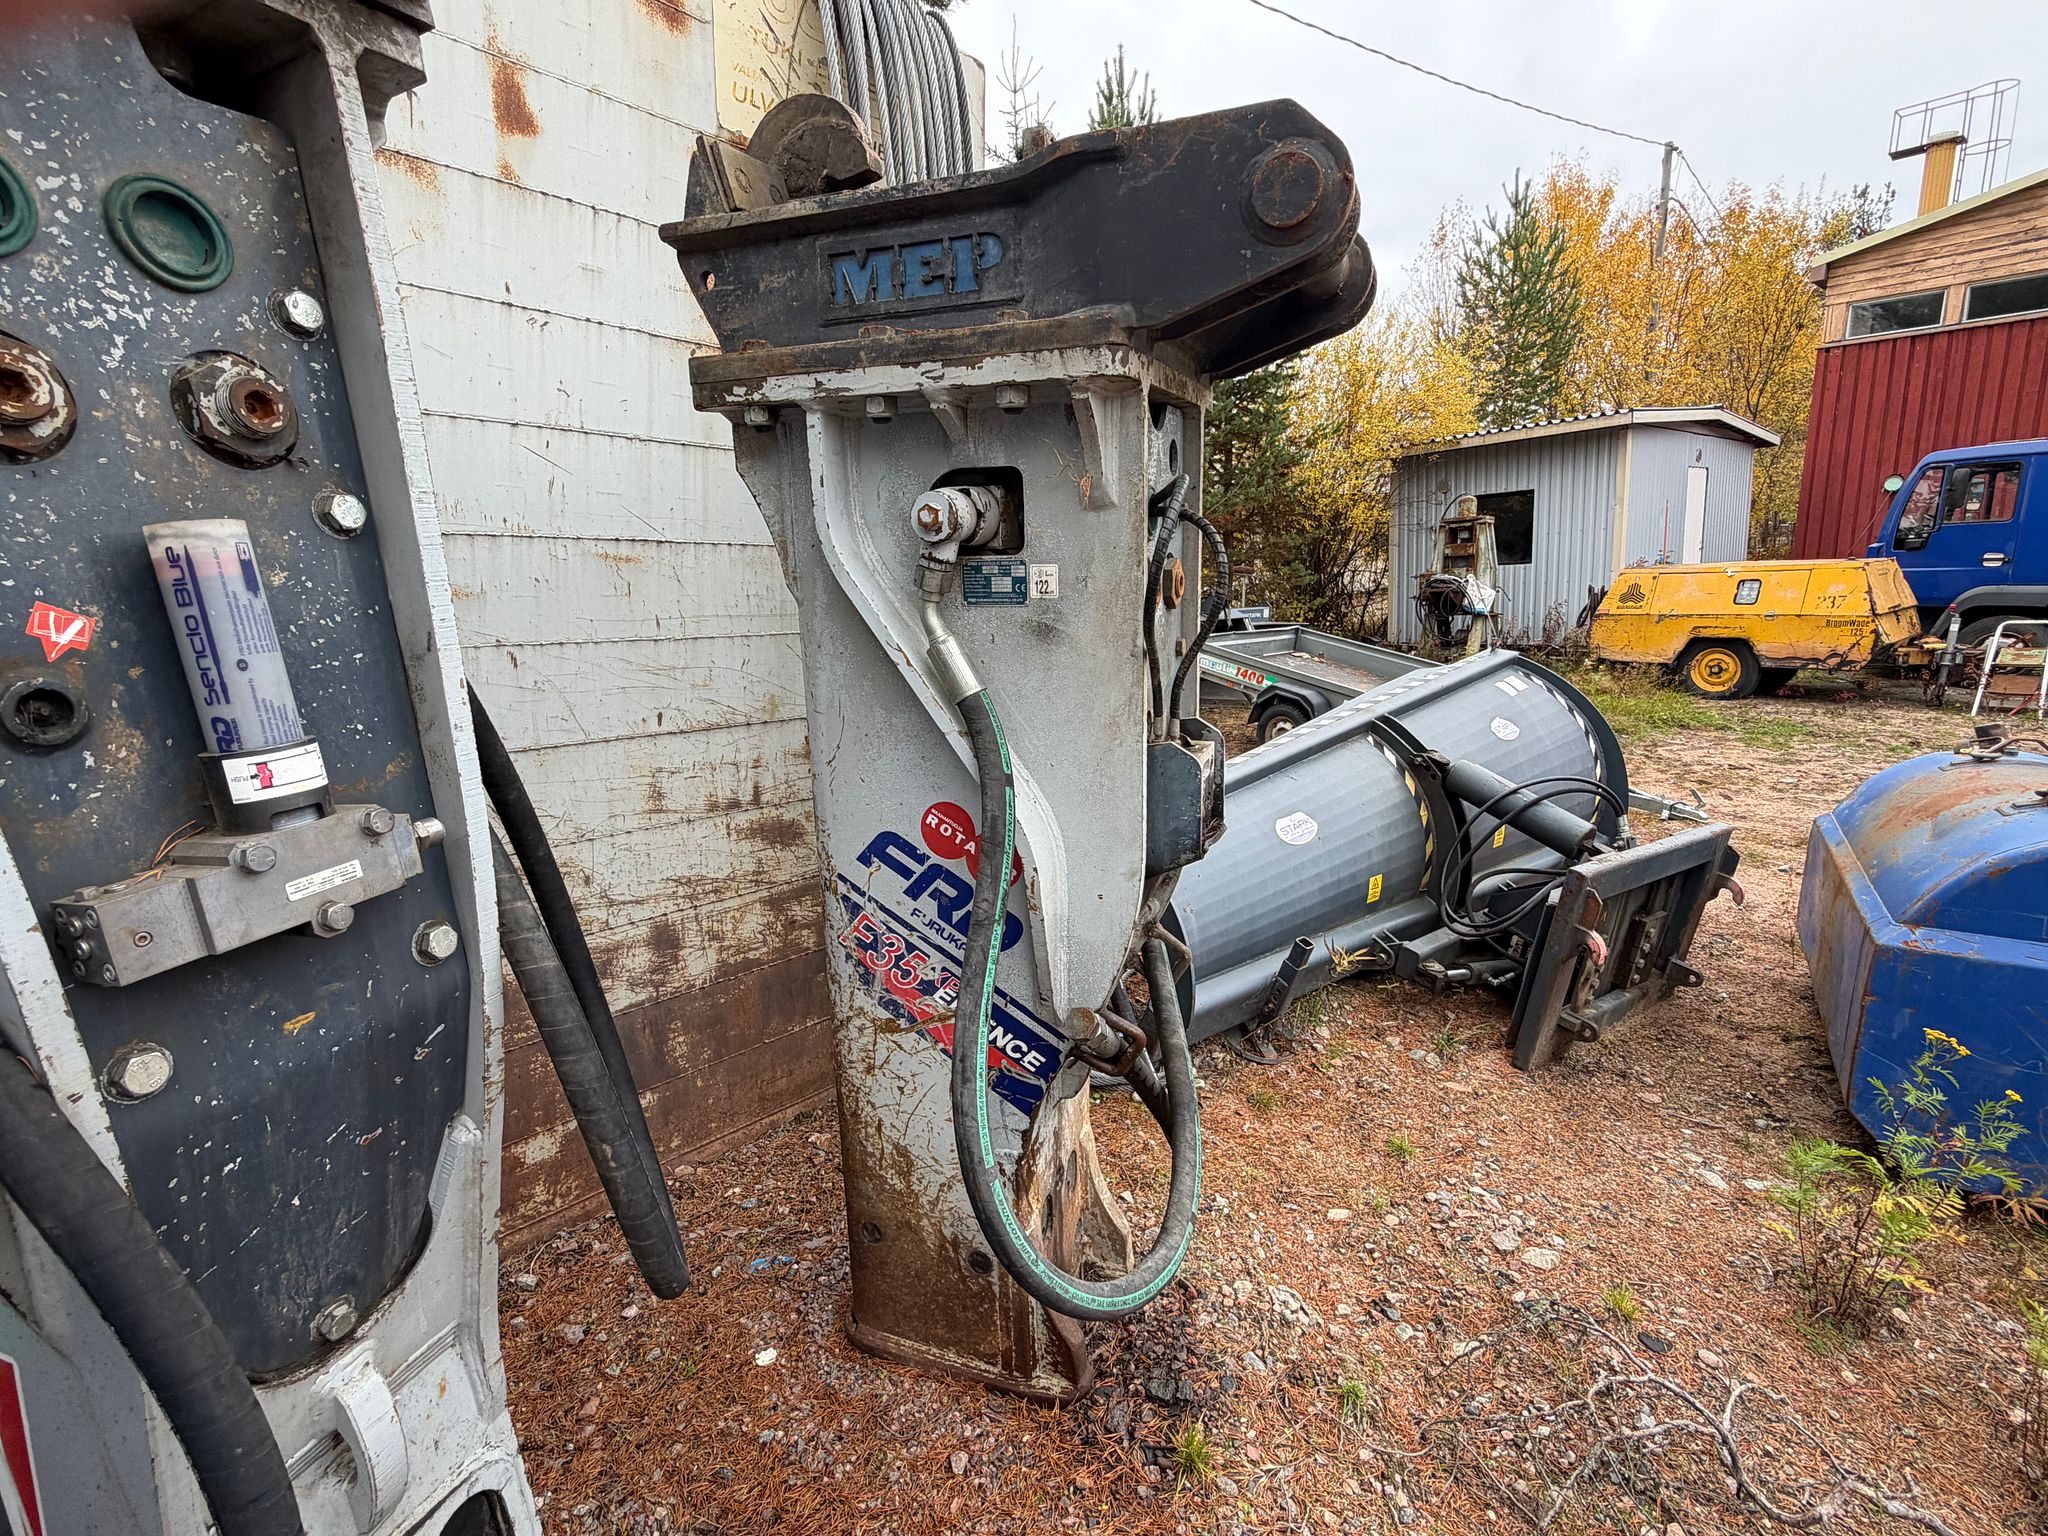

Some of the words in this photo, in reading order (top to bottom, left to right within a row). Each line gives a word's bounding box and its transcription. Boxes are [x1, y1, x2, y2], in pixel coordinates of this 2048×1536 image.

[827, 231, 1004, 306] MEP
[165, 546, 193, 608] Blue
[1034, 579, 1049, 595] 122
[1825, 618, 1871, 628] BroomWade
[1850, 627, 1864, 637] 125
[1234, 666, 1265, 686] 1400
[211, 716, 240, 753] RD
[1004, 804, 1014, 851] DUNLOP
[1280, 818, 1313, 836] STARK
[856, 831, 1024, 952] FRD
[996, 1198, 1024, 1244] DUNLOP
